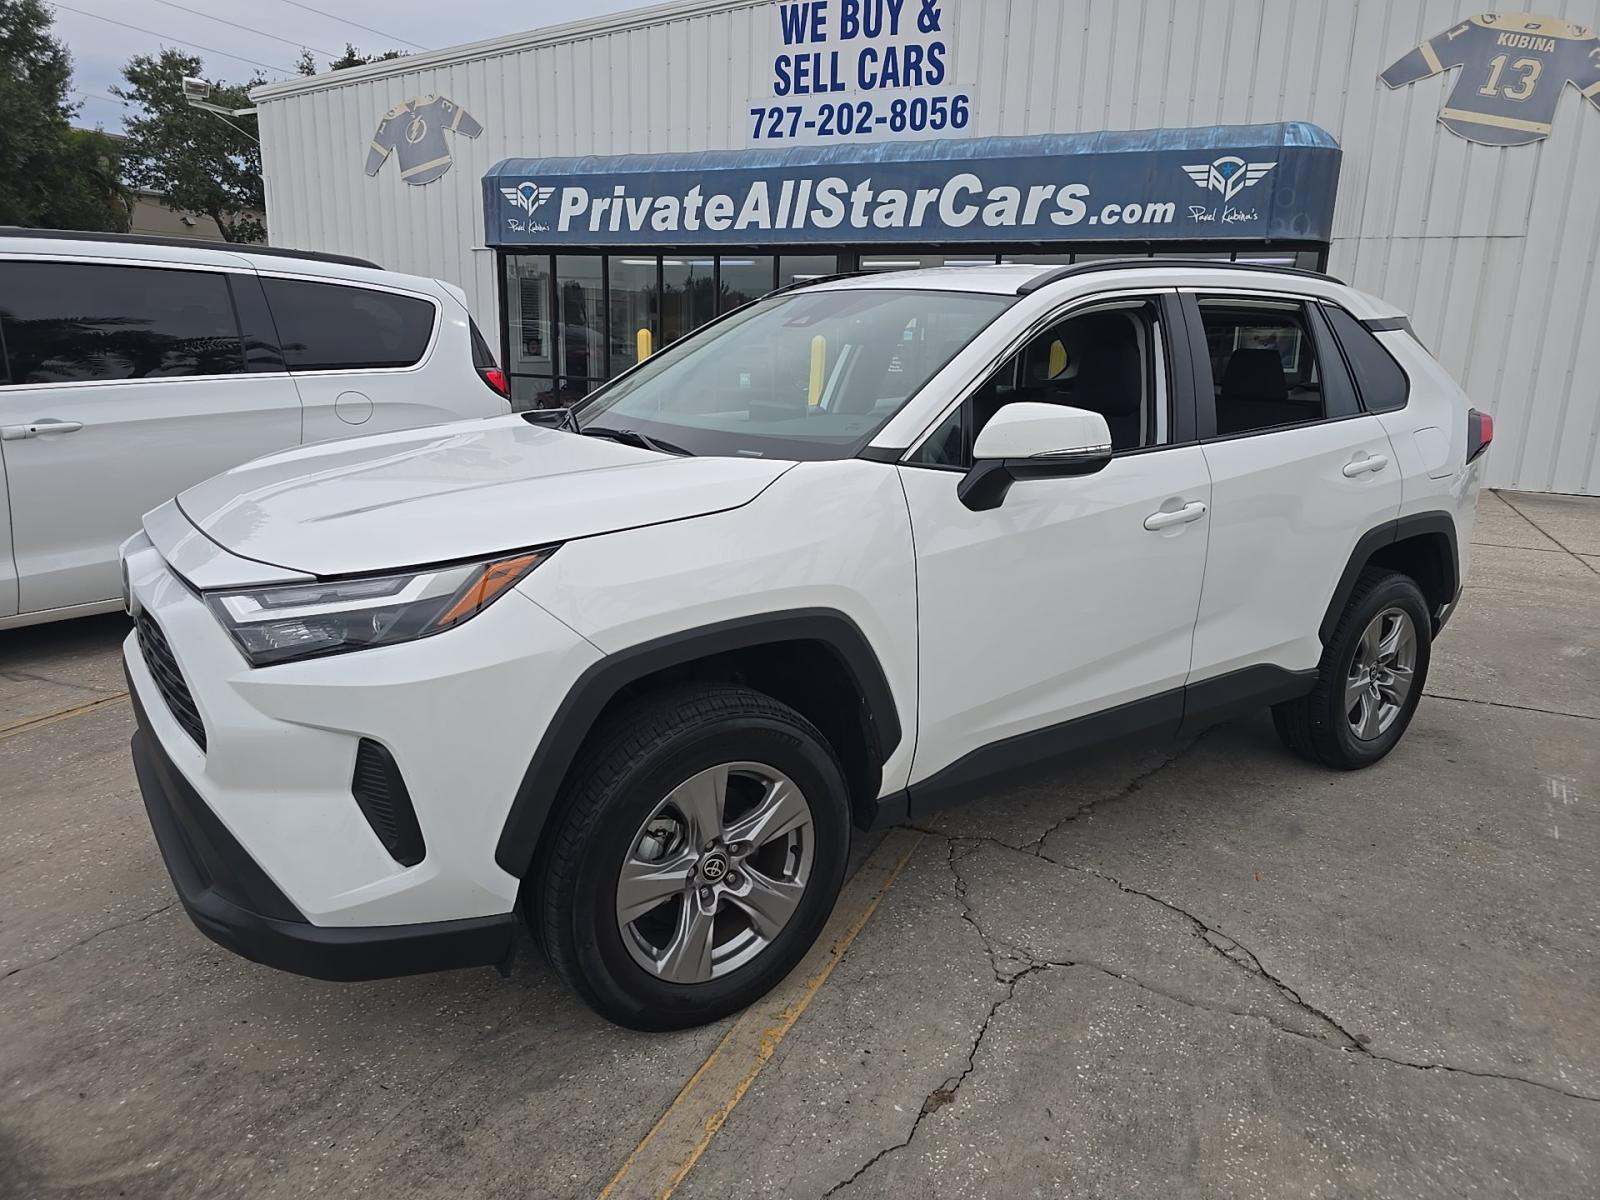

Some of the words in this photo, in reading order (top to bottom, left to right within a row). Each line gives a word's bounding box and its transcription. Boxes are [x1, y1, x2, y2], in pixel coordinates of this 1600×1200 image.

[780, 1, 828, 45] WE
[840, 0, 904, 40] BUY
[916, 0, 941, 33] &
[1497, 32, 1556, 53] KUBINA
[774, 51, 846, 97] SELL
[857, 41, 946, 91] CARS
[1478, 53, 1543, 102] 13
[750, 94, 969, 139] 727-202-8056
[557, 173, 1176, 232] PrivateAllStarCars.com
